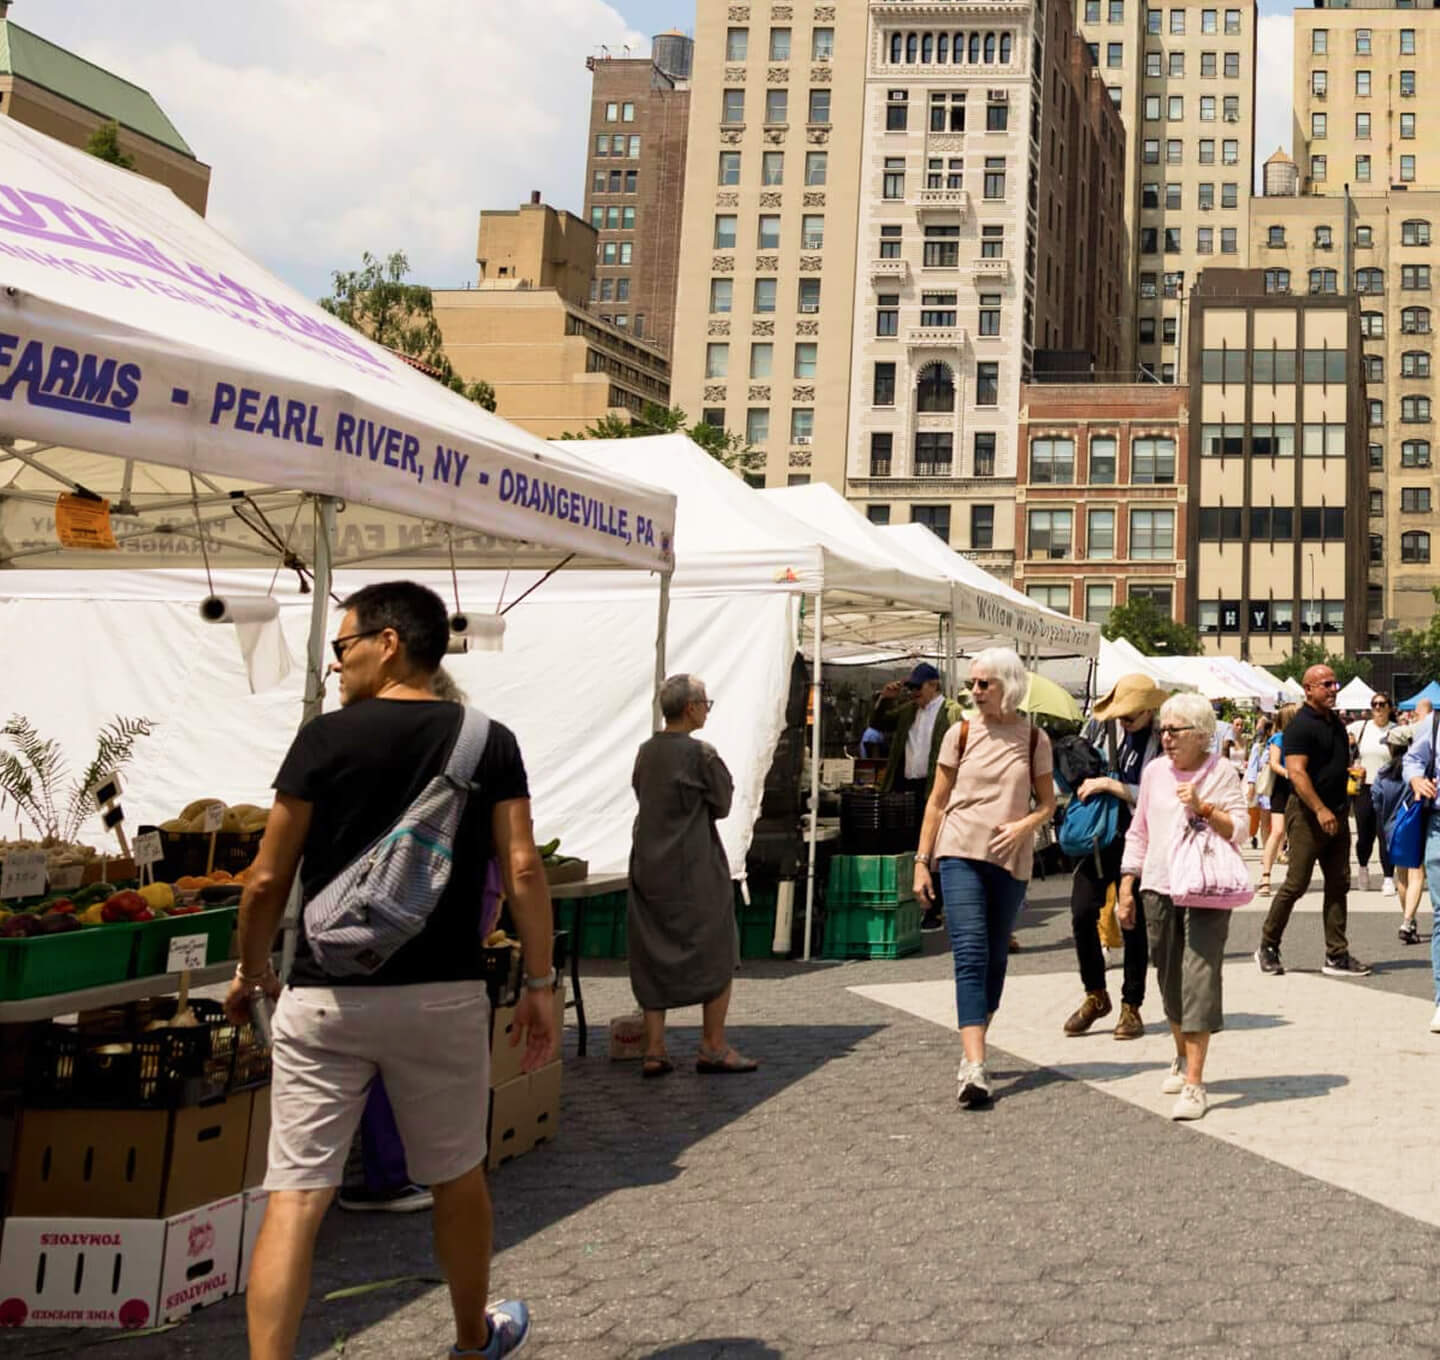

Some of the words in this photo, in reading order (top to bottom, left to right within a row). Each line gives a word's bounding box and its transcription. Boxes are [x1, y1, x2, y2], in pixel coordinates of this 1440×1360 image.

[209, 381, 324, 447] PEARL
[334, 412, 425, 483] RIVER,
[433, 446, 469, 487] NY
[499, 468, 634, 546] ORANGEVILLE,
[636, 515, 656, 547] PA
[40, 1233, 121, 1246] TOMATOES
[165, 1271, 228, 1310] TOMATOES
